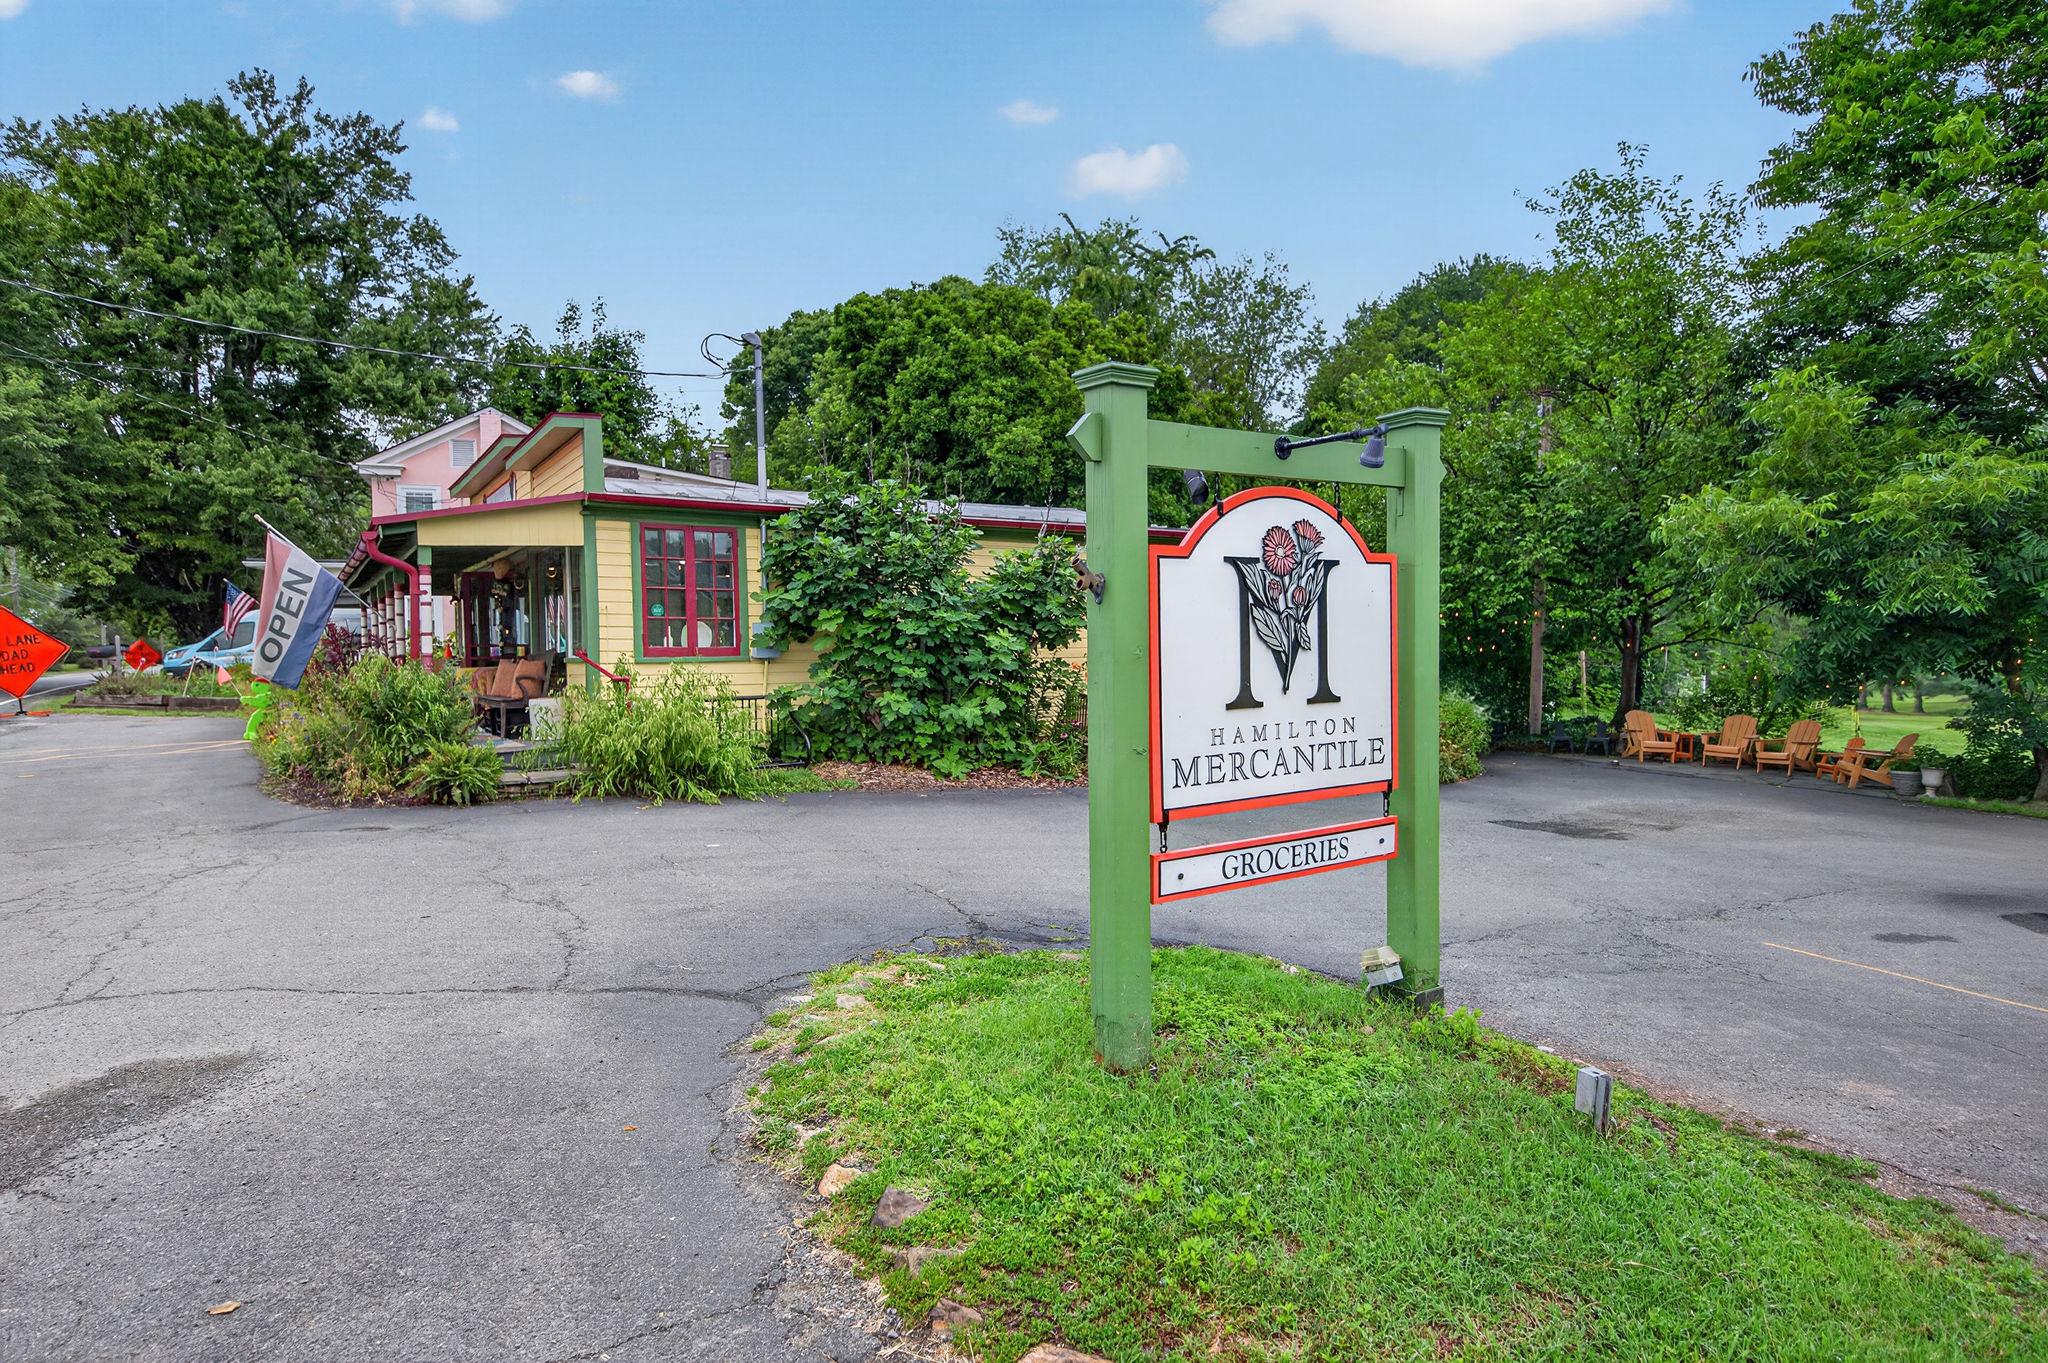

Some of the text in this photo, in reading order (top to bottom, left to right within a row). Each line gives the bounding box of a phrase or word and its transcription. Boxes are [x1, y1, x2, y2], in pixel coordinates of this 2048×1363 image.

[260, 567, 313, 663] OPEN
[0, 649, 28, 662] OAD
[6, 634, 41, 647] LANE
[0, 662, 35, 675] HEAD
[1210, 717, 1356, 747] HAMILTON
[1171, 737, 1386, 789] MERCANTILE
[1222, 836, 1349, 880] GROCERIES
